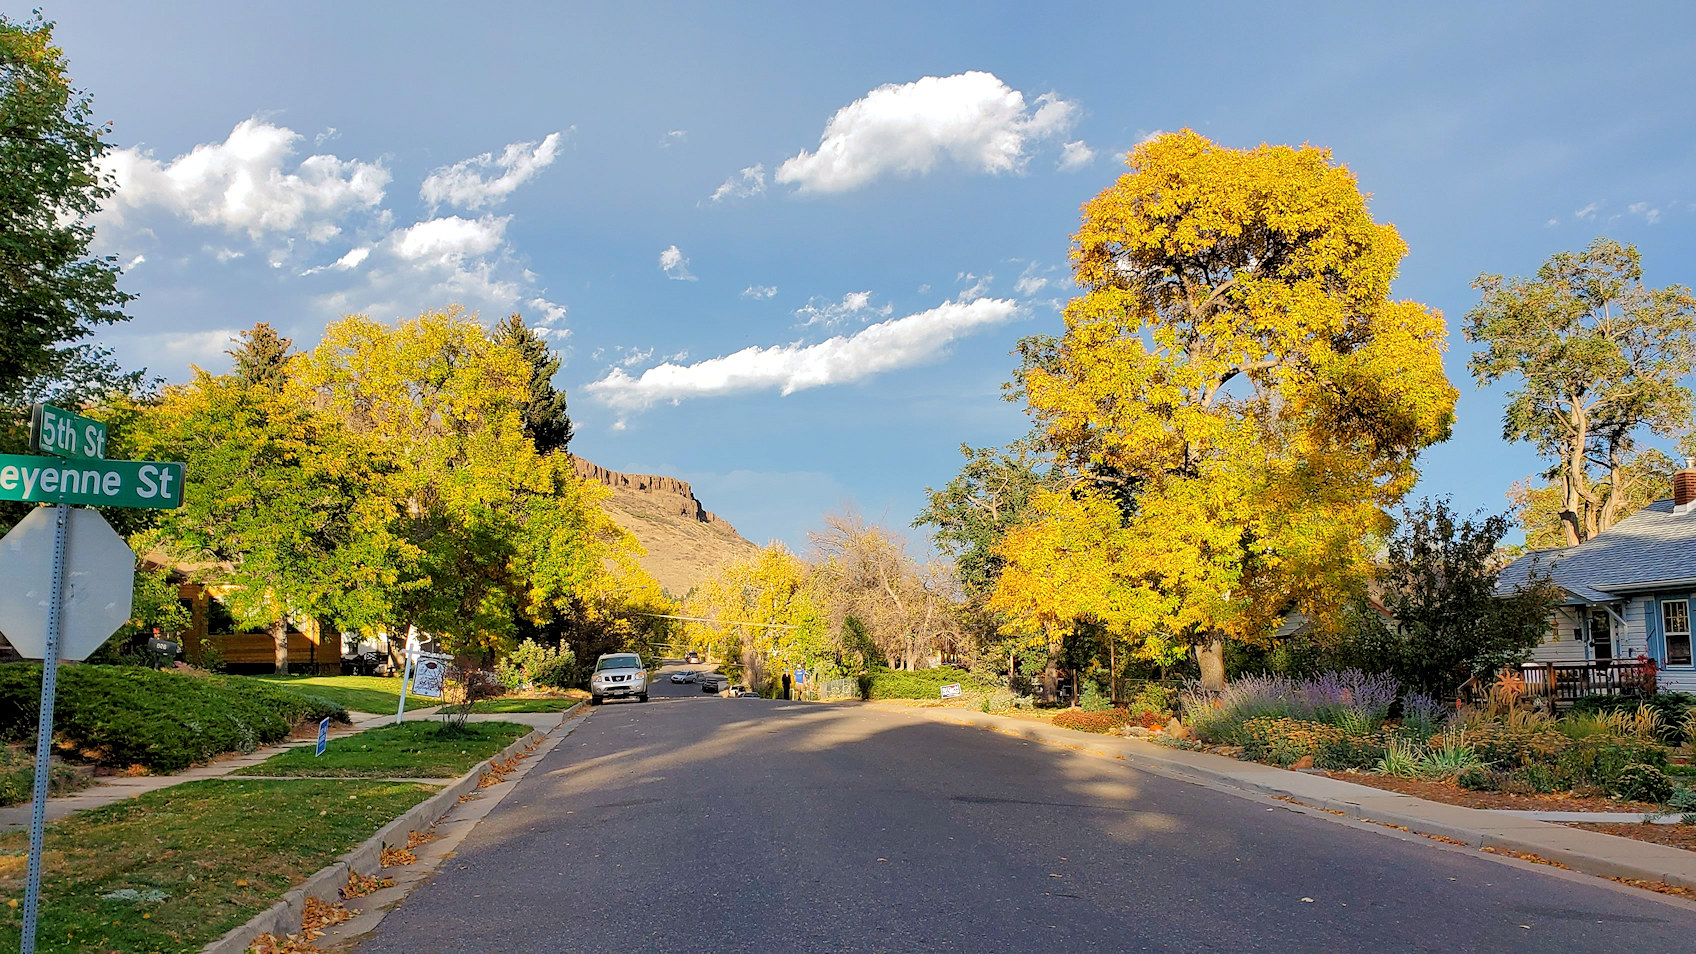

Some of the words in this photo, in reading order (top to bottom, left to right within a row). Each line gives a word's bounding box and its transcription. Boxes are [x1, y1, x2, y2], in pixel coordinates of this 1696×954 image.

[43, 411, 76, 452] 5th
[84, 425, 104, 459] St
[0, 465, 121, 499] eyenne
[136, 465, 173, 499] St
